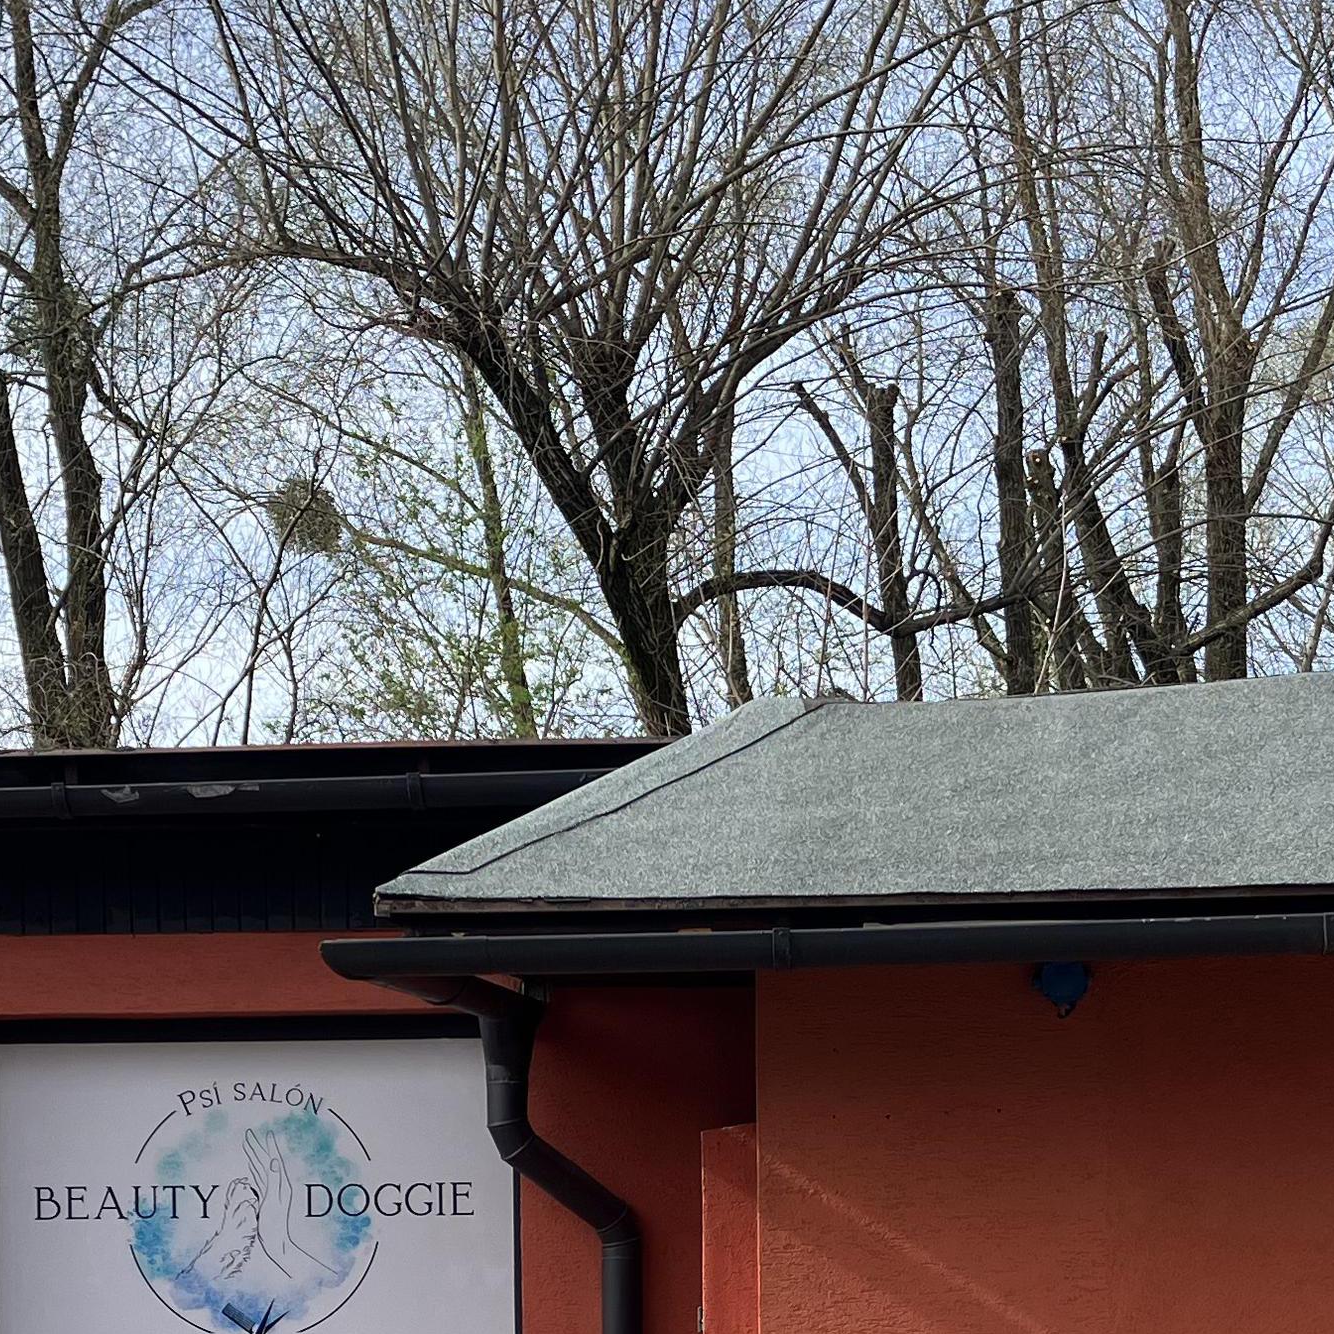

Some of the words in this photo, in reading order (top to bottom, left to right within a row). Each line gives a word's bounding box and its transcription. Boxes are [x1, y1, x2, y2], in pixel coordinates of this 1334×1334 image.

[233, 1080, 324, 1114] SALÓN
[35, 1184, 220, 1221] BEAUTY
[305, 1181, 475, 1217] DOGGIE
